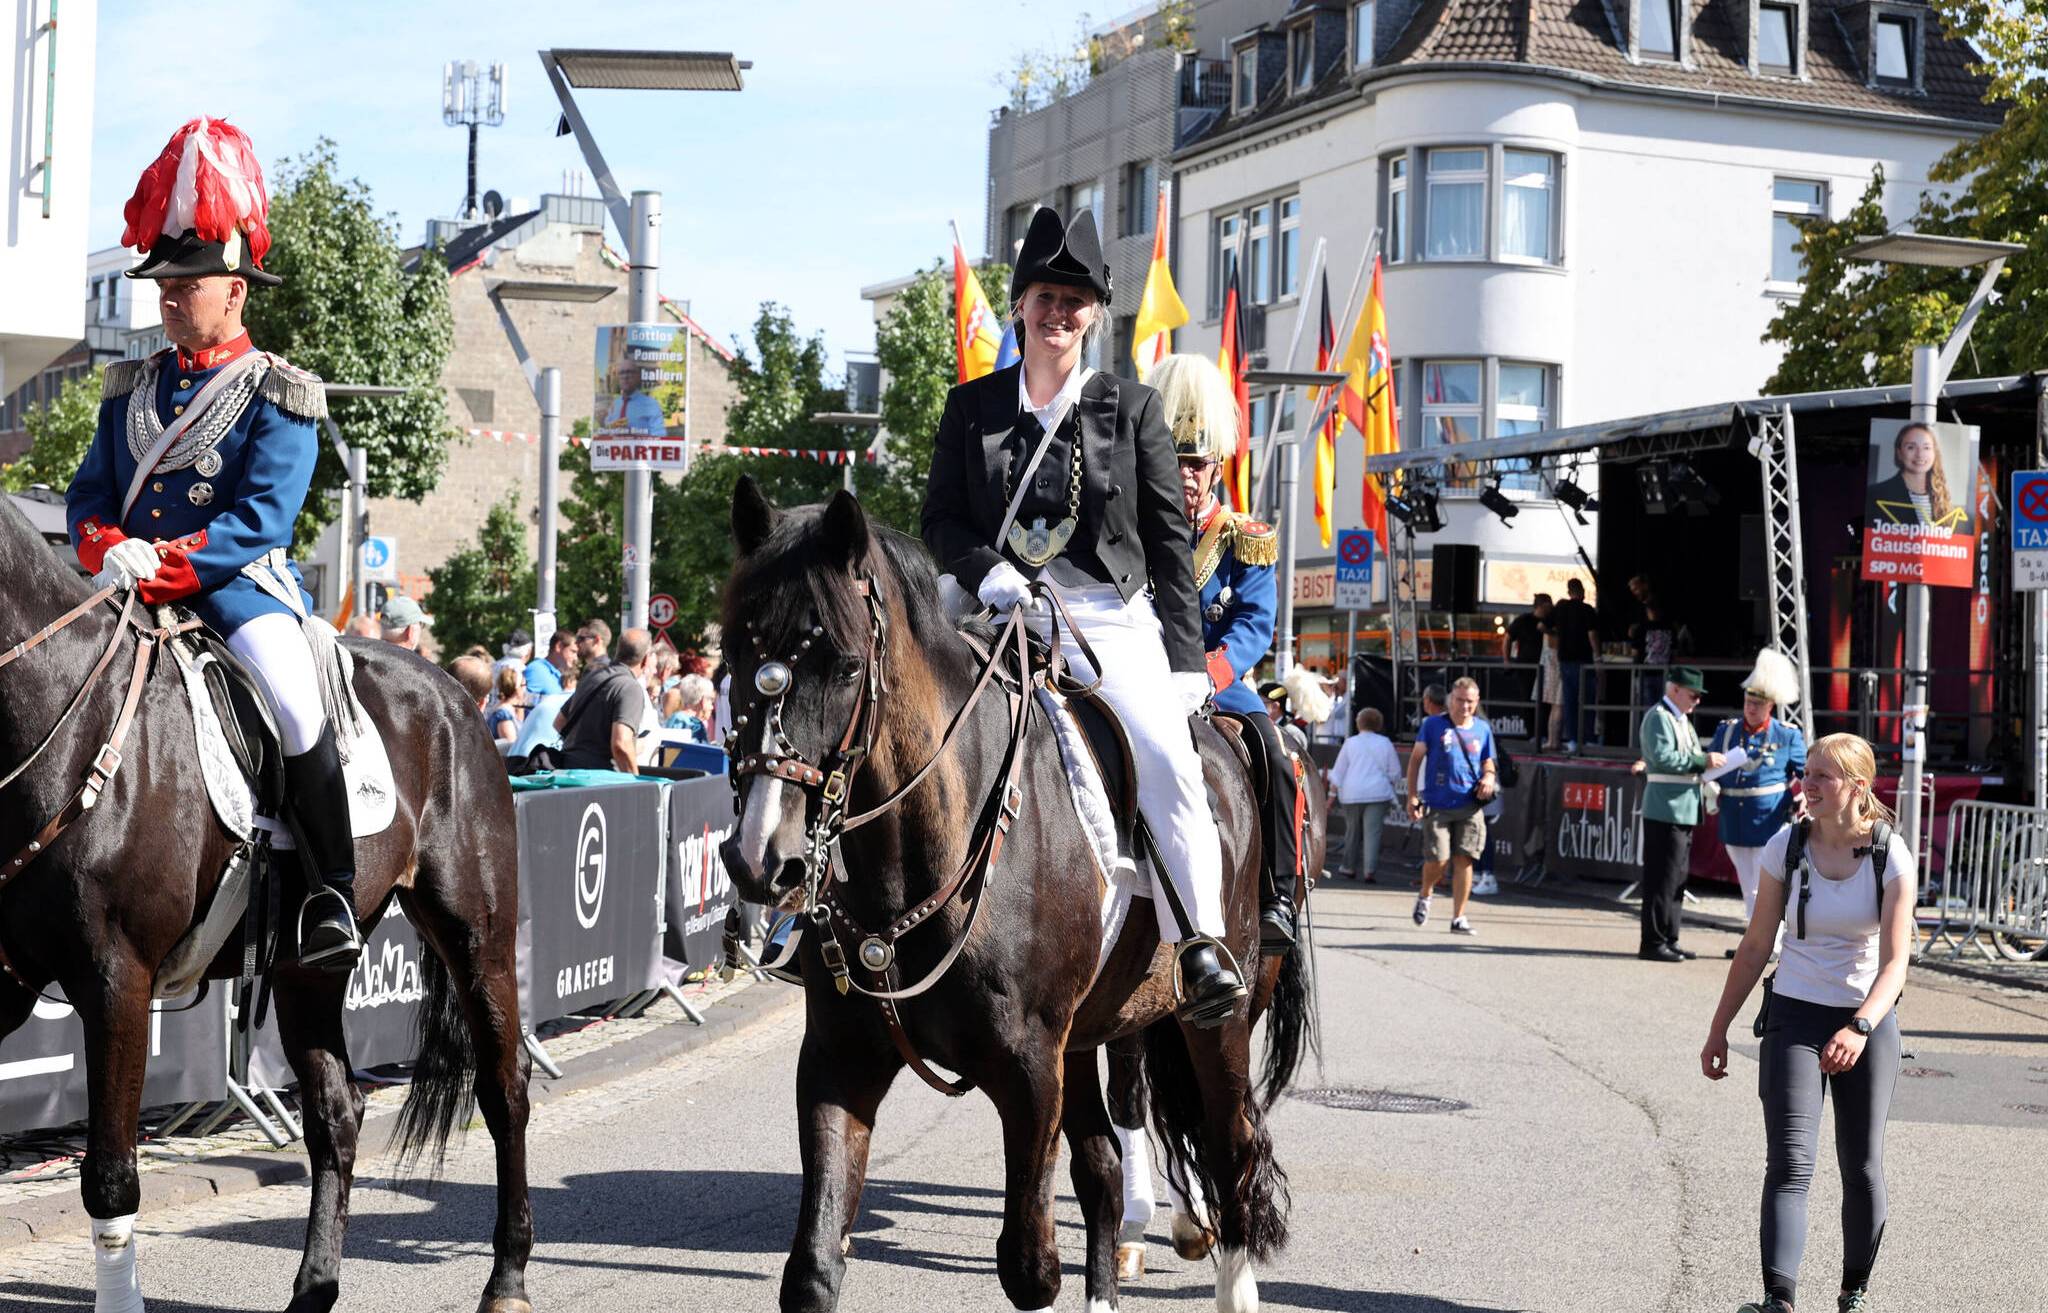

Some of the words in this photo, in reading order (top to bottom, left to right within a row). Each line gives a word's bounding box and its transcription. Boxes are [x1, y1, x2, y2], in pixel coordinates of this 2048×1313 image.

[632, 330, 673, 341] Gottlos
[634, 348, 683, 362] Pommes
[641, 368, 682, 382] ballern
[596, 445, 609, 457] Die
[610, 445, 680, 461] PARTEI
[1872, 519, 1952, 540] Josephine
[1871, 537, 1967, 559] Gauselmann
[1339, 568, 1369, 581] TAXI
[1869, 560, 1897, 573] SPD
[1899, 562, 1924, 576] MG
[557, 955, 614, 999] GRAEFEN
